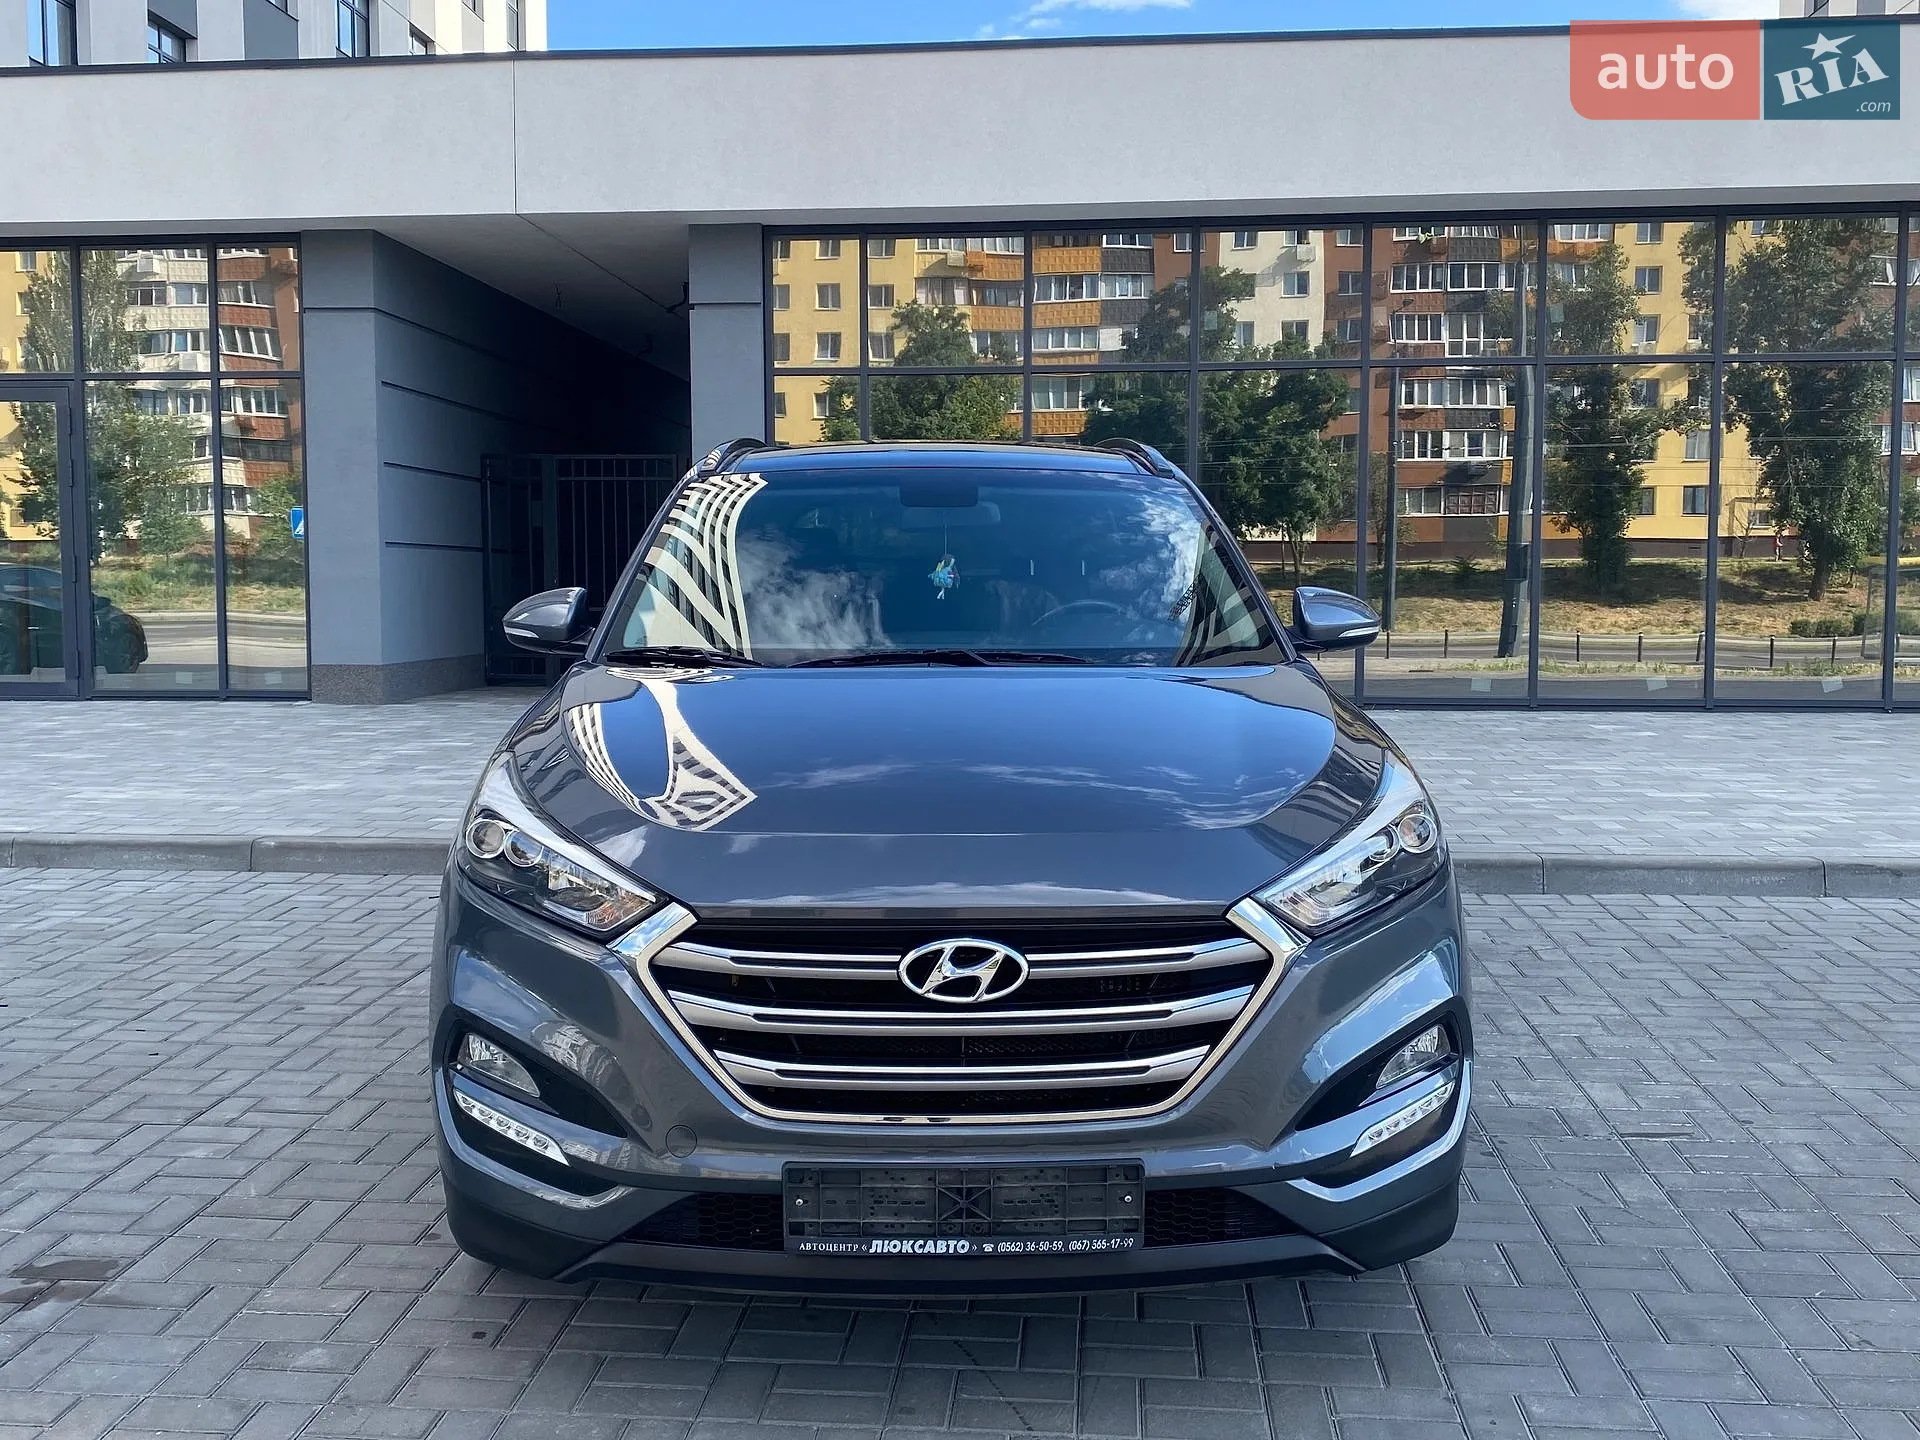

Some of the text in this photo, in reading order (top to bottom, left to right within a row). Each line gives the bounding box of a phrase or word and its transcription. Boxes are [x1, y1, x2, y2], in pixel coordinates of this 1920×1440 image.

[799, 1242, 859, 1252] АВТОЦЕНТР
[997, 1241, 1024, 1253] (0562)
[1025, 1240, 1065, 1253] 36-50-59,
[1068, 1239, 1090, 1251] (067)
